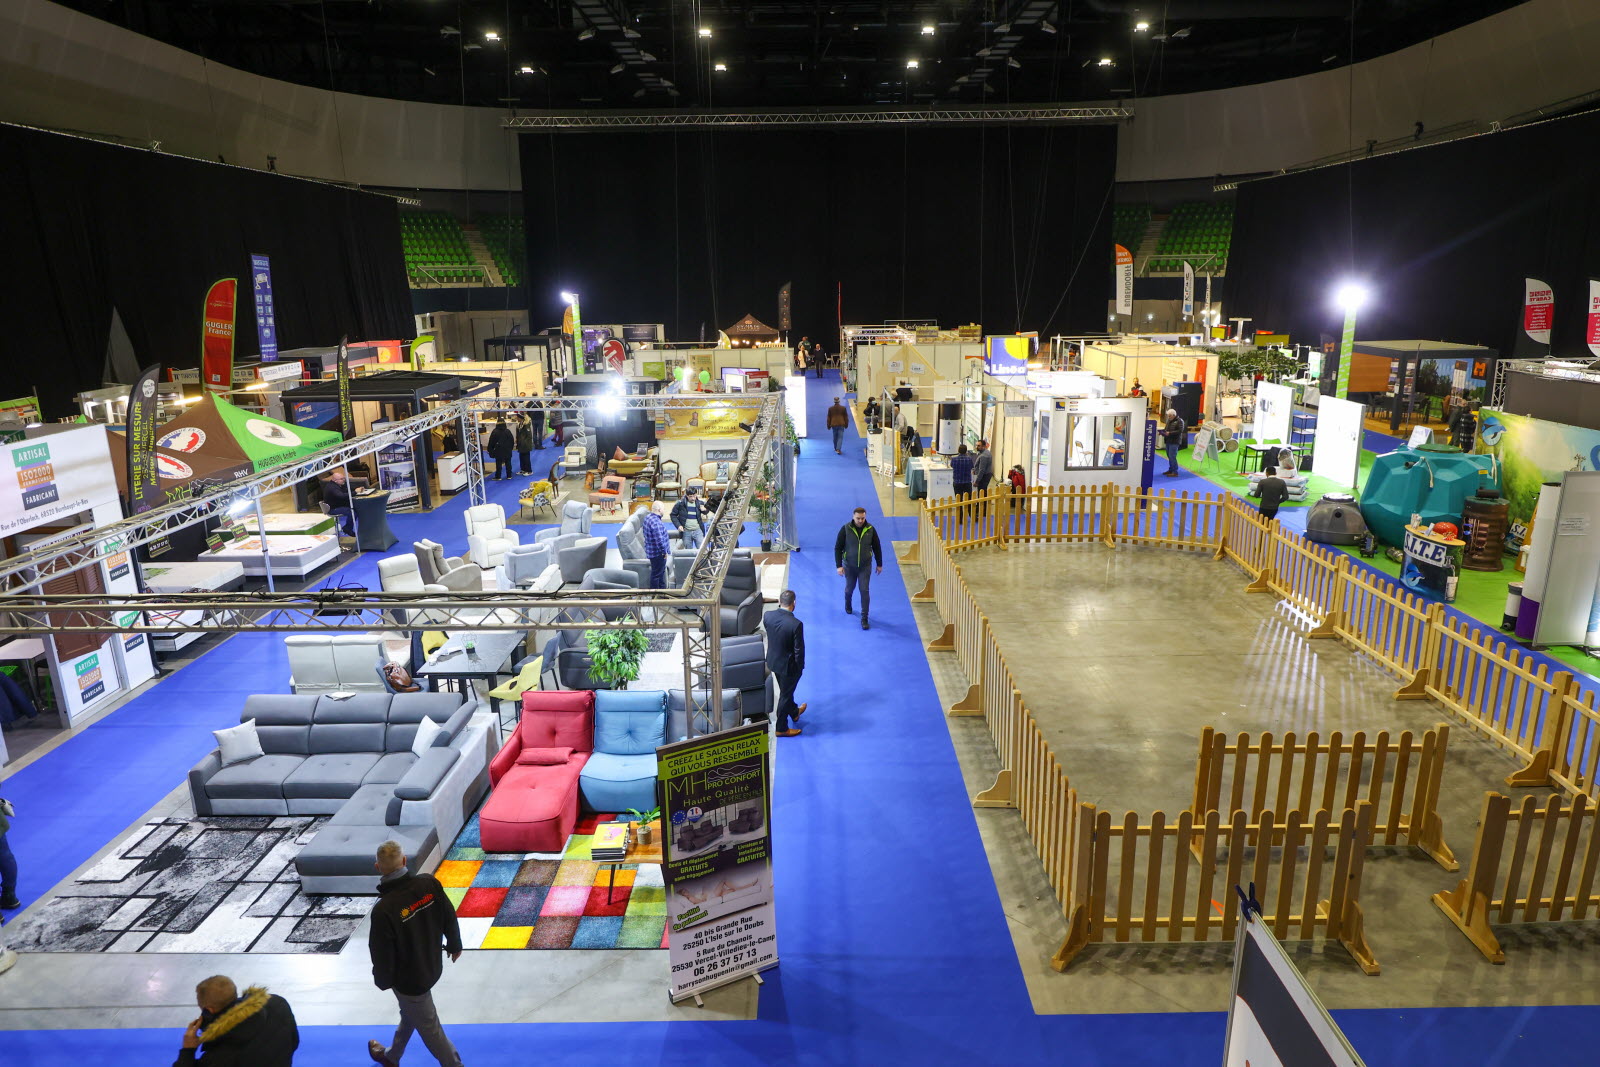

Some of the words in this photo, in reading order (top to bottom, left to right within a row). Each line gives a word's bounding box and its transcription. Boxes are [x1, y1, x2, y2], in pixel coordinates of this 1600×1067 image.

[205, 321, 233, 330] GUGLER
[208, 327, 232, 336] France
[133, 401, 142, 441] MESURE
[18, 447, 47, 462] ARTISAL
[133, 443, 141, 462] SUR
[1145, 436, 1153, 462] Fenêtre
[20, 465, 51, 481] ISO2000
[149, 455, 158, 486] Maison
[234, 469, 248, 478] RHV
[133, 465, 144, 500] LITERIE
[26, 489, 56, 505] FABRICANT
[0, 523, 10, 531] Rue
[78, 657, 97, 672] ARTISAL
[706, 745, 735, 757] SALON
[737, 738, 761, 749] RELAX
[670, 767, 686, 776] QUI
[688, 761, 711, 771] VOUS
[714, 747, 759, 764] RESSEMBLE
[669, 771, 707, 801] MH
[707, 778, 723, 790] PRO
[726, 769, 761, 785] CONFORT
[683, 795, 712, 807] Haute
[715, 784, 749, 798] Qualité
[680, 862, 709, 874] GRATUITS
[737, 851, 766, 864] GRATUITES
[677, 906, 701, 921] Facilité
[683, 939, 704, 950] 25250
[705, 934, 723, 944] L'Isle
[724, 930, 735, 938] sur
[744, 920, 764, 931] Doubs
[693, 932, 703, 940] 40
[716, 921, 739, 932] Grande
[740, 916, 753, 924] Rue
[672, 961, 694, 973] 25530
[694, 934, 775, 966] Vercel-Villedieu-le-Camp
[702, 946, 716, 955] Rue
[717, 943, 725, 951] du
[727, 934, 753, 946] Chanois
[678, 953, 773, 991] harrysonhuguenin@gmail.com
[693, 966, 705, 977] 06
[707, 963, 718, 972] 26
[720, 958, 731, 968] 37
[733, 953, 744, 963] 57
[747, 948, 757, 958] 13
